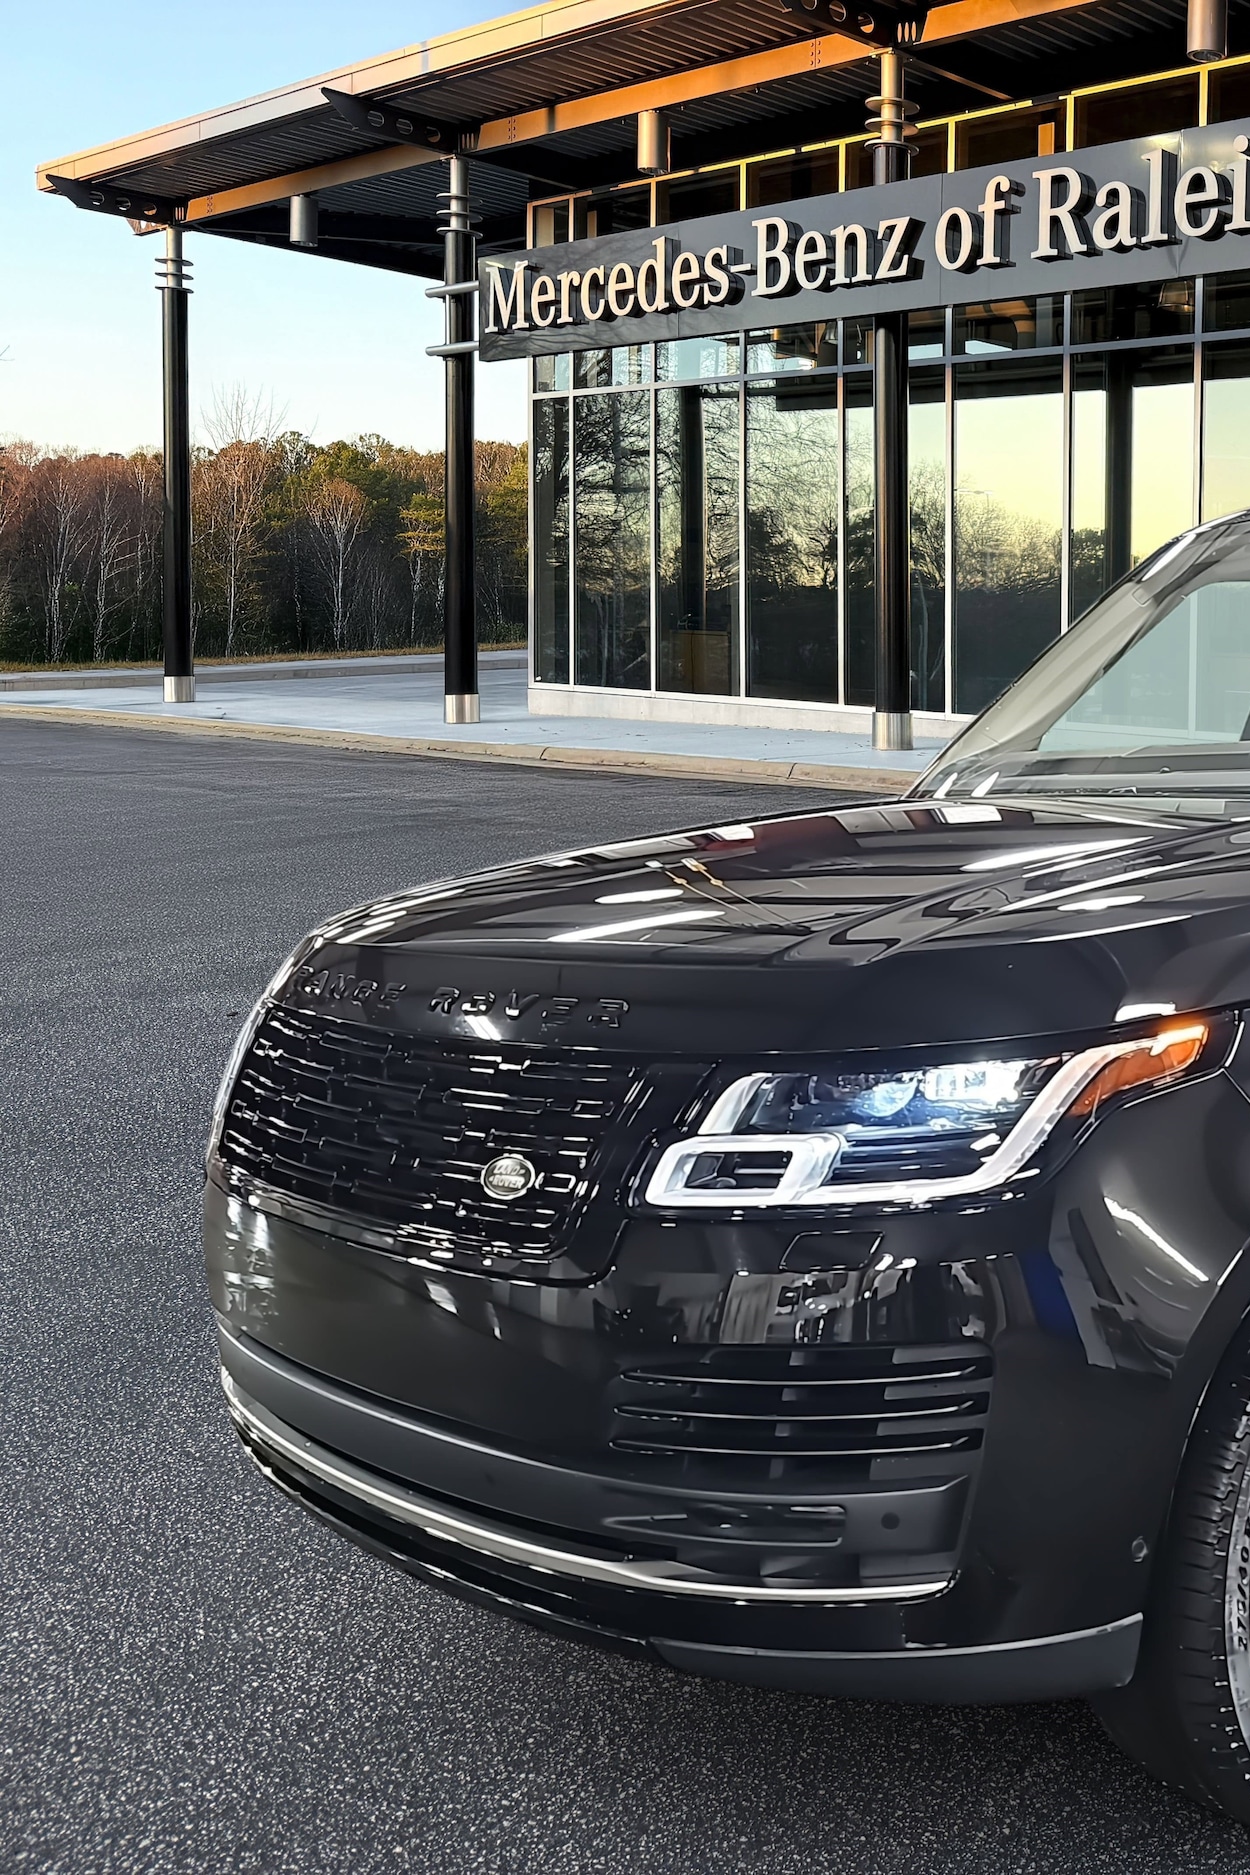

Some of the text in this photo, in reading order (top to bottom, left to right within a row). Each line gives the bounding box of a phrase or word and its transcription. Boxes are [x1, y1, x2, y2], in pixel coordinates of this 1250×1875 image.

[484, 215, 914, 336] Mercedes-Benz
[934, 174, 1013, 273] of
[427, 985, 631, 1029] ROVER
[492, 1175, 526, 1189] ROVER
[493, 1162, 521, 1175] LAND
